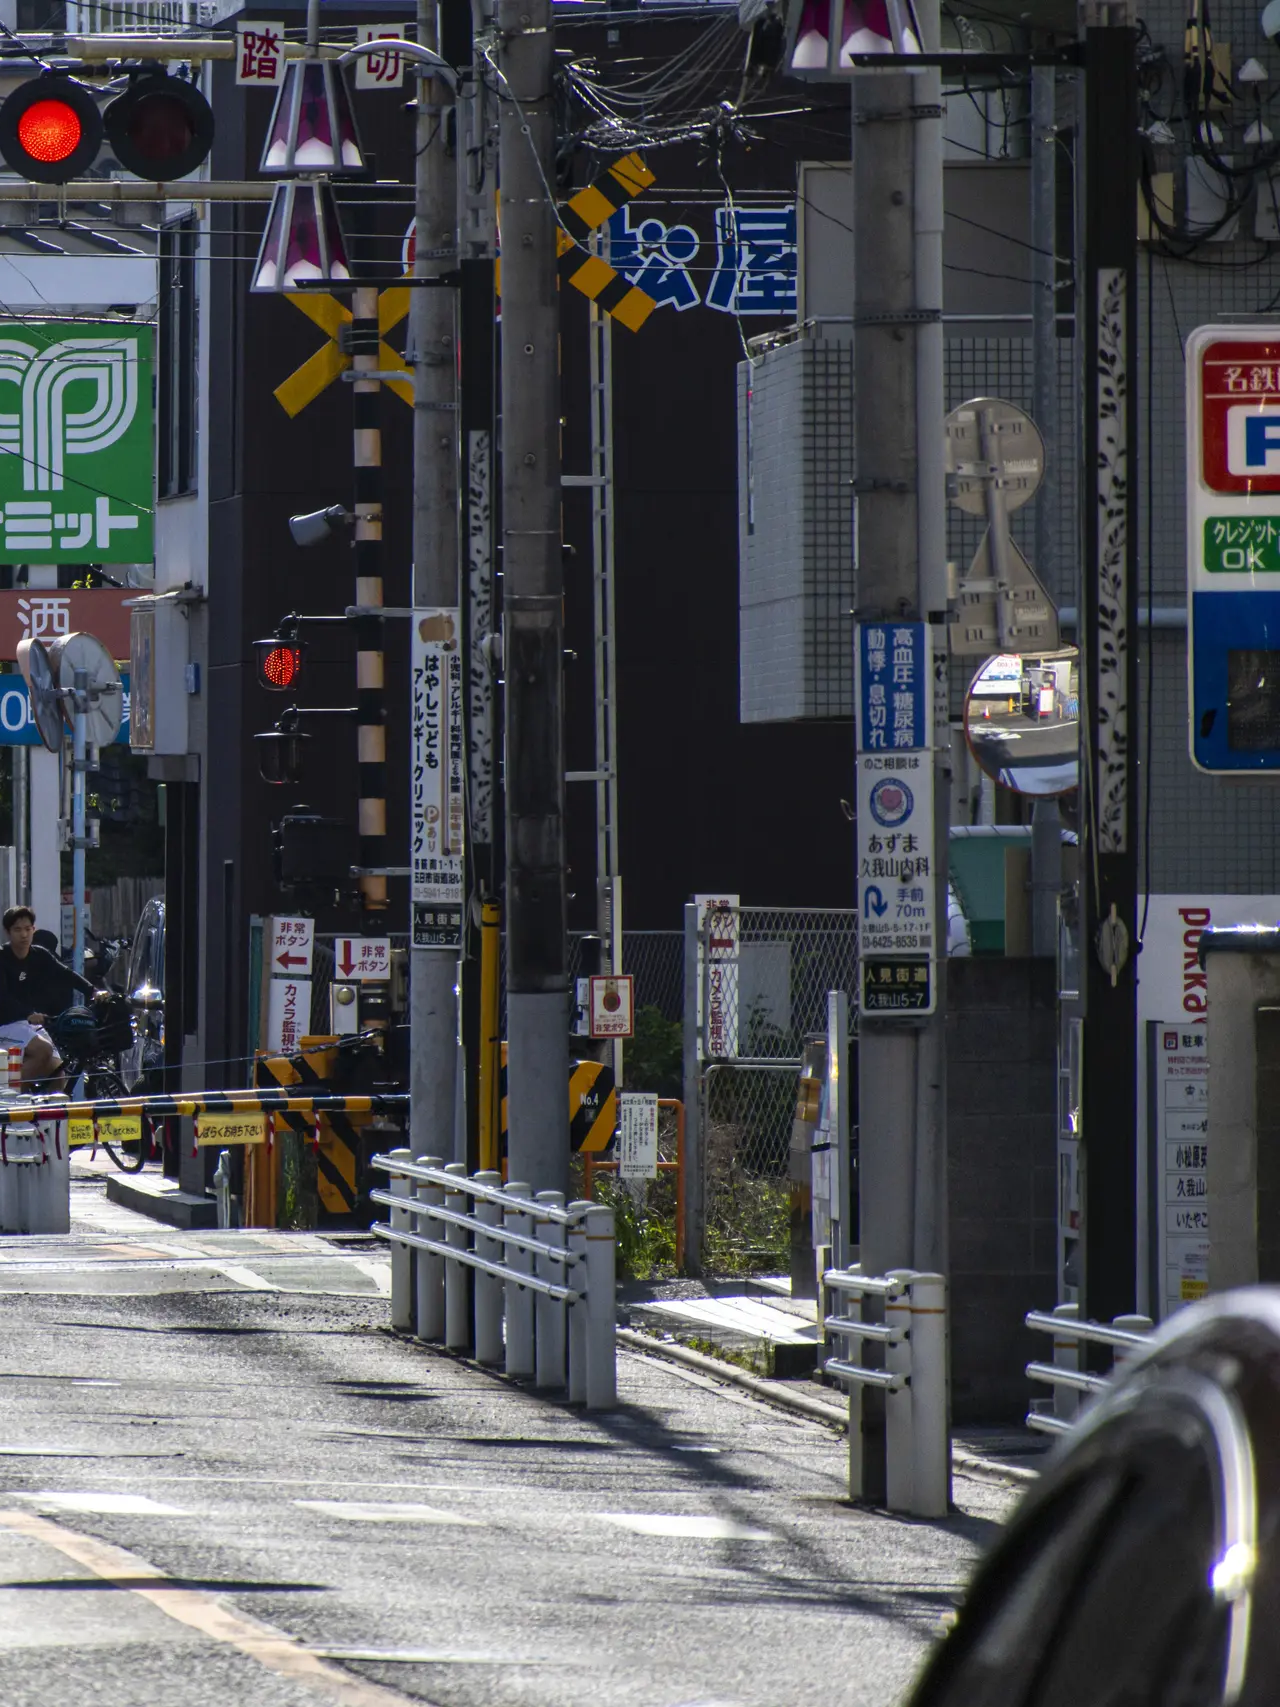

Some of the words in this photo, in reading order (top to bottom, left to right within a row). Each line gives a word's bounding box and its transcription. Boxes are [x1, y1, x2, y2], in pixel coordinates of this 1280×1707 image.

[241, 28, 280, 79] 踏
[367, 32, 400, 82] 切
[1224, 366, 1280, 392] 名鉄
[1222, 549, 1265, 568] OK
[867, 629, 887, 748] 動悸・息切れ
[892, 628, 914, 747] 高血圧・糖尿病
[425, 655, 439, 769] はやしこども
[414, 668, 424, 853] アレルギークリニック
[864, 757, 920, 770] のご相談は
[868, 833, 919, 854] あずま
[861, 856, 930, 878] 久我山内科
[896, 888, 924, 902] 手前
[896, 904, 925, 917] 70m
[414, 913, 461, 925] 人見街道
[280, 922, 306, 934] 非常
[275, 936, 309, 947] ボタン
[415, 931, 459, 944] 久我山5-7
[361, 945, 386, 958] 非常
[358, 960, 389, 972] ボタン
[866, 967, 928, 983] 人見街道
[868, 992, 924, 1008] 久我山5-7
[1182, 1035, 1208, 1048] 駐車
[580, 1092, 599, 1106] No.4
[1176, 1177, 1207, 1198] 久我山
